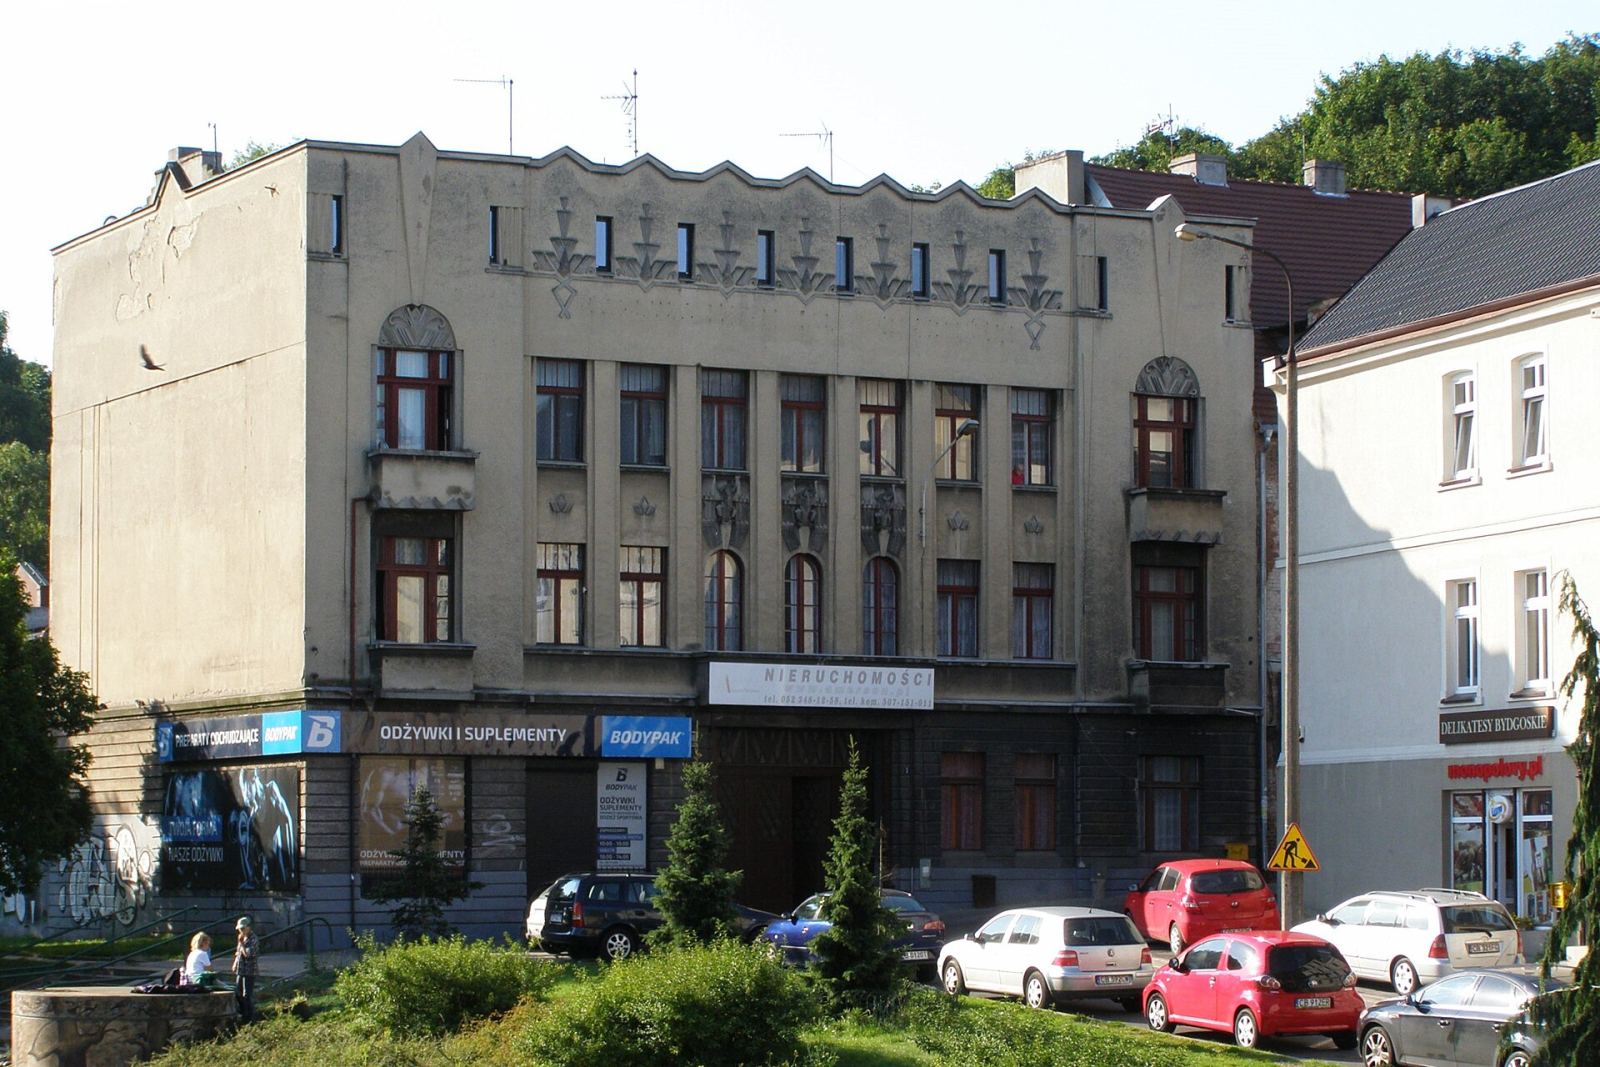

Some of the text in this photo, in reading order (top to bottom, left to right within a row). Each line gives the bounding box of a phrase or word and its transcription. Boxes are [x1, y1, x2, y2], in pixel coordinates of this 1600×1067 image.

[764, 668, 932, 687] NIERUCHOMOŚCI
[264, 726, 299, 743] BODYPAK
[380, 722, 567, 742] ODŻYWKI I SUPLEMENTY
[1441, 715, 1547, 735] DELIKATESY BYDGOSKIE
[175, 728, 259, 748] PREPARATY ODCHUDZAJĄCE
[610, 730, 681, 745] BODYPAK
[1447, 755, 1543, 783] monopolowy.pl
[600, 796, 636, 804] ODŻYWKI
[168, 847, 191, 862] NASZE
